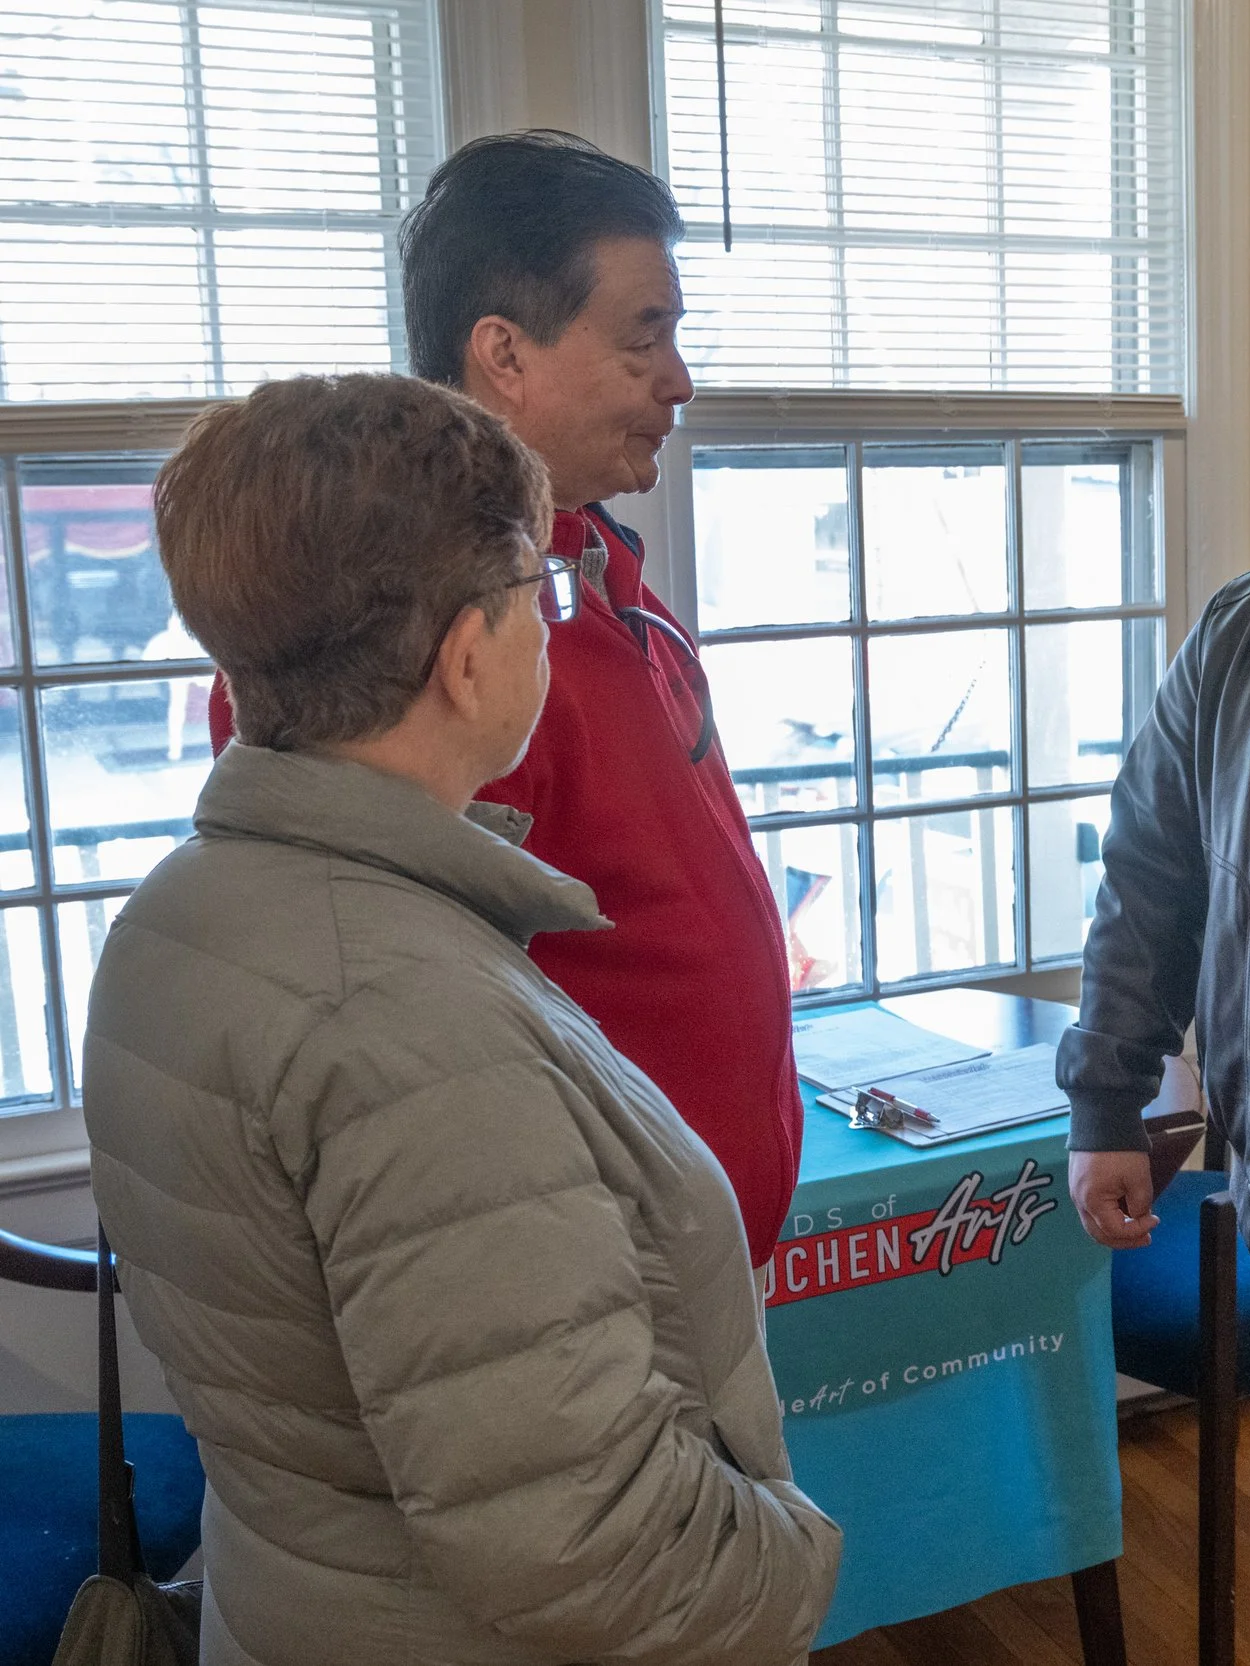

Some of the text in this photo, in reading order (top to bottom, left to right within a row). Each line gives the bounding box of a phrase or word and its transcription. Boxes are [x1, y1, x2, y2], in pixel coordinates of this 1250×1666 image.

[871, 1194, 897, 1219] of
[910, 1160, 1057, 1275] Arts
[862, 1371, 890, 1394] of
[903, 1332, 1064, 1384] Community
